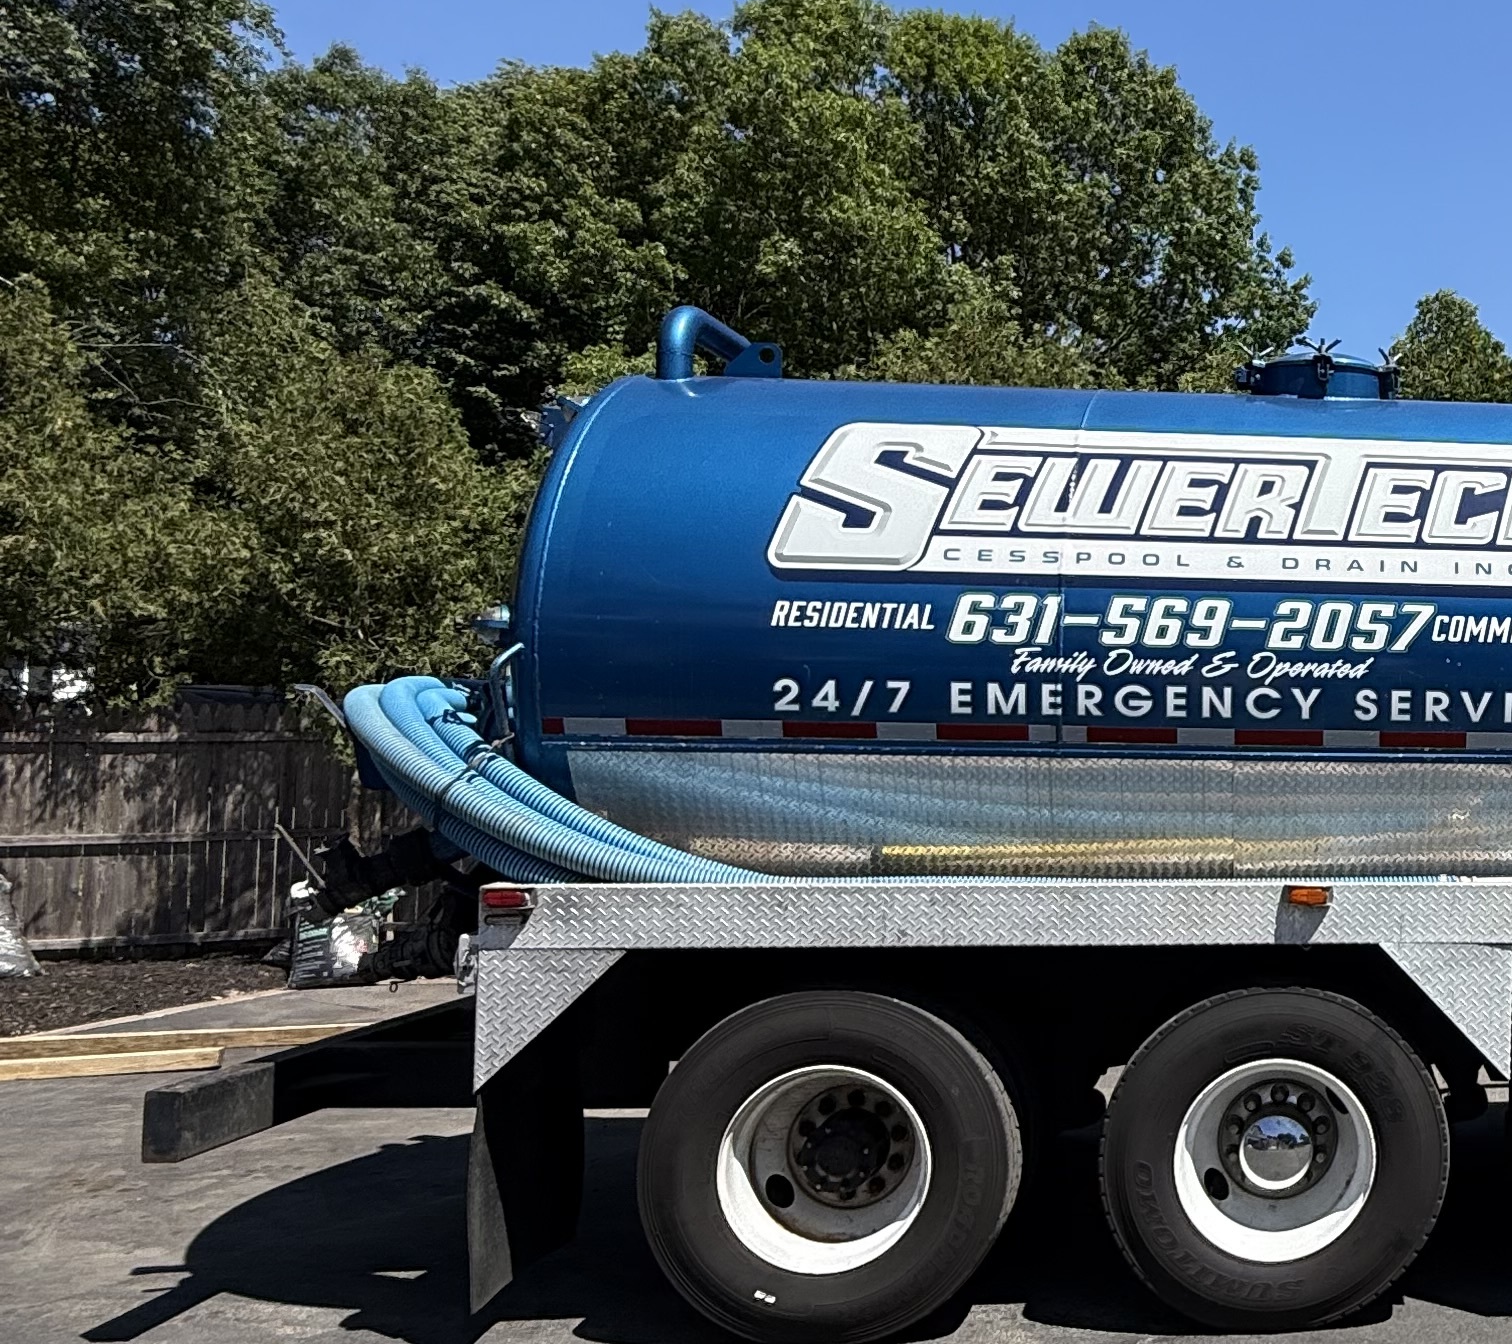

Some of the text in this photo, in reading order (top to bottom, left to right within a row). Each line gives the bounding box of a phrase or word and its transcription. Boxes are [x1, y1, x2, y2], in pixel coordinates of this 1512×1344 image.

[943, 547, 1190, 567] CESSPOOL
[1226, 556, 1245, 568] &
[1282, 556, 1418, 573] DRAIN
[771, 600, 935, 630] RESIDENTIAL
[947, 593, 1435, 653] 631-569-2057
[1009, 647, 1375, 684] Family Owned & Operated
[773, 680, 911, 716] 24/7
[949, 682, 1323, 721] EMERGENCY
